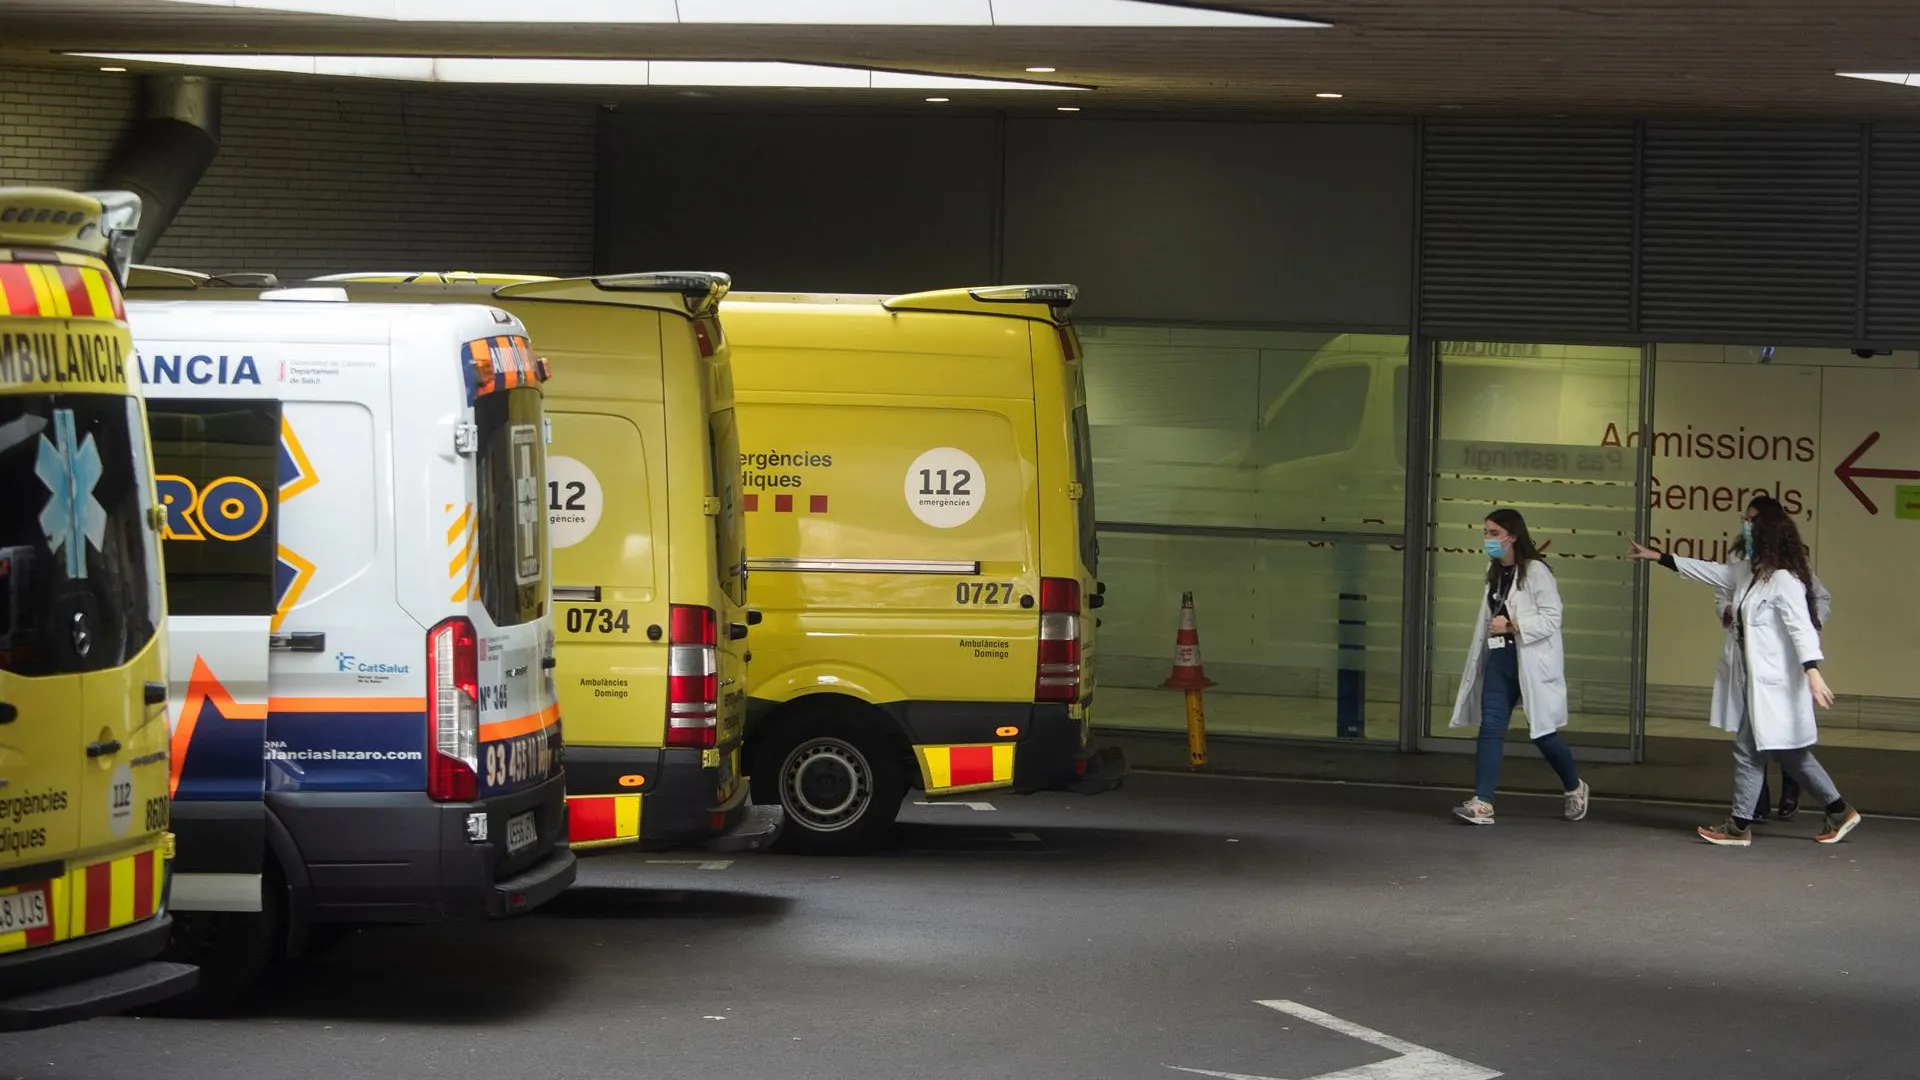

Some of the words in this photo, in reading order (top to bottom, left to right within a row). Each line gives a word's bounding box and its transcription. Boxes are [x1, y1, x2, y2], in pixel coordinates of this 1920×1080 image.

[0, 320, 126, 383] MBULÀNCIA
[919, 469, 971, 495] 112
[548, 481, 586, 510] 12
[956, 582, 1014, 605] 0727
[567, 608, 629, 633] 0734
[974, 650, 1009, 659] Domingo
[358, 663, 409, 673] CatSalut
[594, 689, 628, 699] Domingo
[486, 743, 506, 787] 93
[113, 783, 131, 808] 112
[19, 895, 44, 925] JJS
